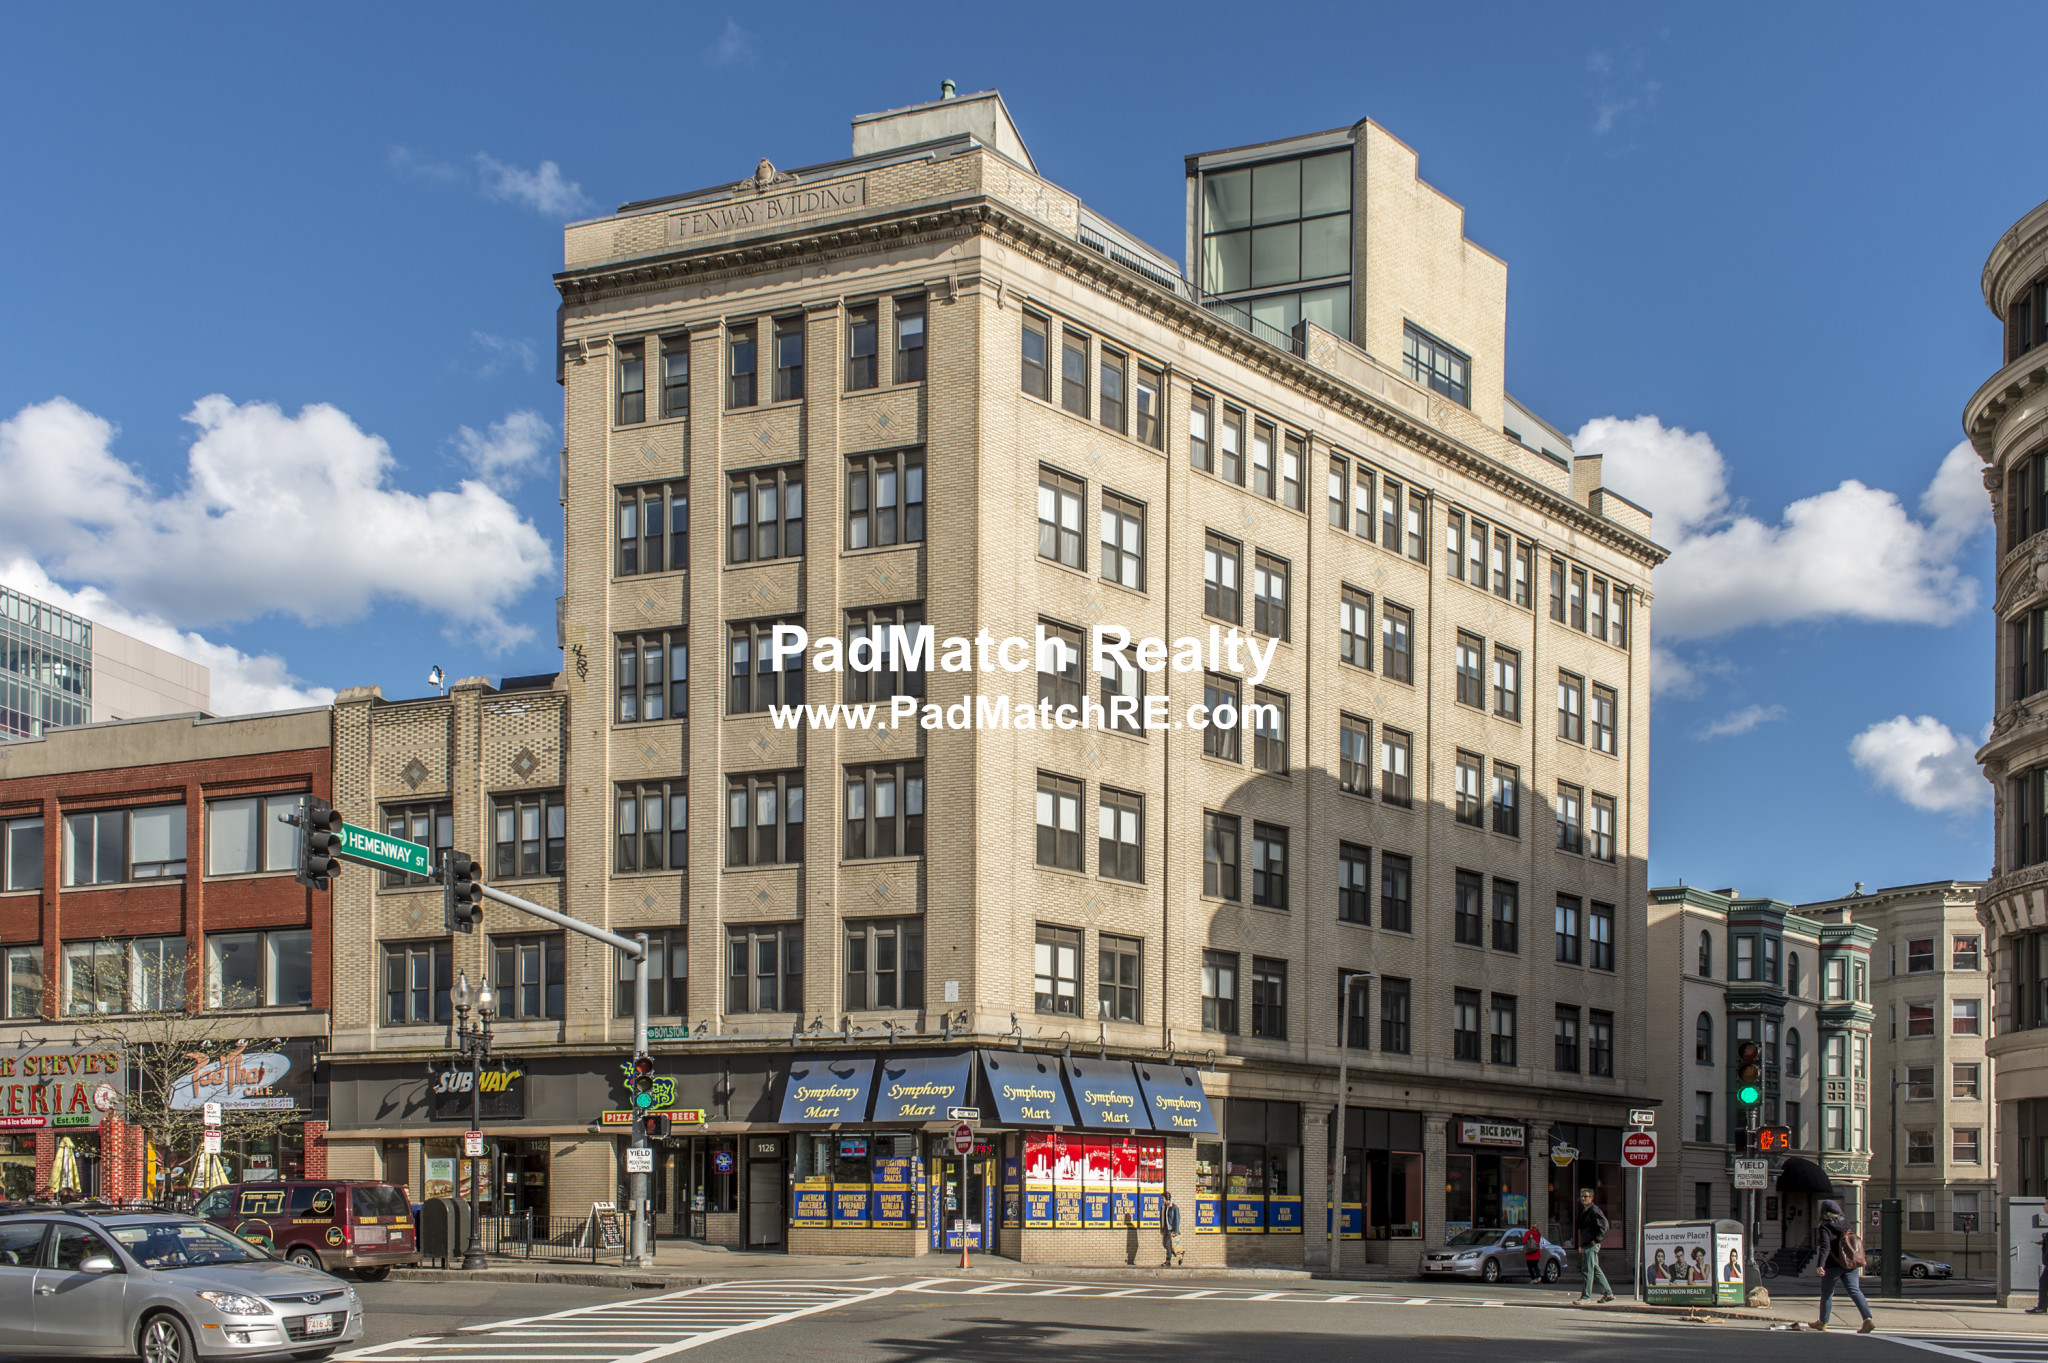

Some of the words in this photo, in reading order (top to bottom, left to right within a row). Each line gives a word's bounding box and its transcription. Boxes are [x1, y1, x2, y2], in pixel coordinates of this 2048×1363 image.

[679, 208, 758, 236] FENWAY
[349, 832, 411, 862] HEMENWAY
[415, 856, 425, 867] ST
[655, 1026, 686, 1038] BOYLSTON
[24, 1051, 118, 1076] STEVE'S
[185, 1052, 226, 1098] Pad
[433, 1069, 521, 1094] SUBWAY
[794, 1084, 859, 1101] Symphony
[888, 1082, 955, 1099] Symphony
[1003, 1085, 1055, 1103] Symphony
[1084, 1090, 1134, 1107] Symphony
[1155, 1095, 1201, 1112] Symphony
[671, 1112, 695, 1120] BEER
[804, 1106, 840, 1118] Mart
[899, 1104, 936, 1116] Mart
[1021, 1107, 1051, 1120] Mart
[1102, 1111, 1129, 1123] Mart
[1172, 1115, 1198, 1127] Mart
[1480, 1125, 1498, 1136] RICE
[1501, 1127, 1522, 1138] BOWL
[531, 1140, 548, 1150] 1122
[1780, 1133, 1789, 1148] 5
[758, 1144, 774, 1152] 1126
[1008, 1166, 1017, 1176] ATM
[1738, 1161, 1764, 1169] YIELD
[798, 1201, 822, 1209] GROCERIES
[842, 1201, 865, 1209] PREPARED
[882, 1202, 899, 1210] KOREAN
[1687, 1231, 1709, 1239] Place?
[950, 1237, 978, 1247] WELOME
